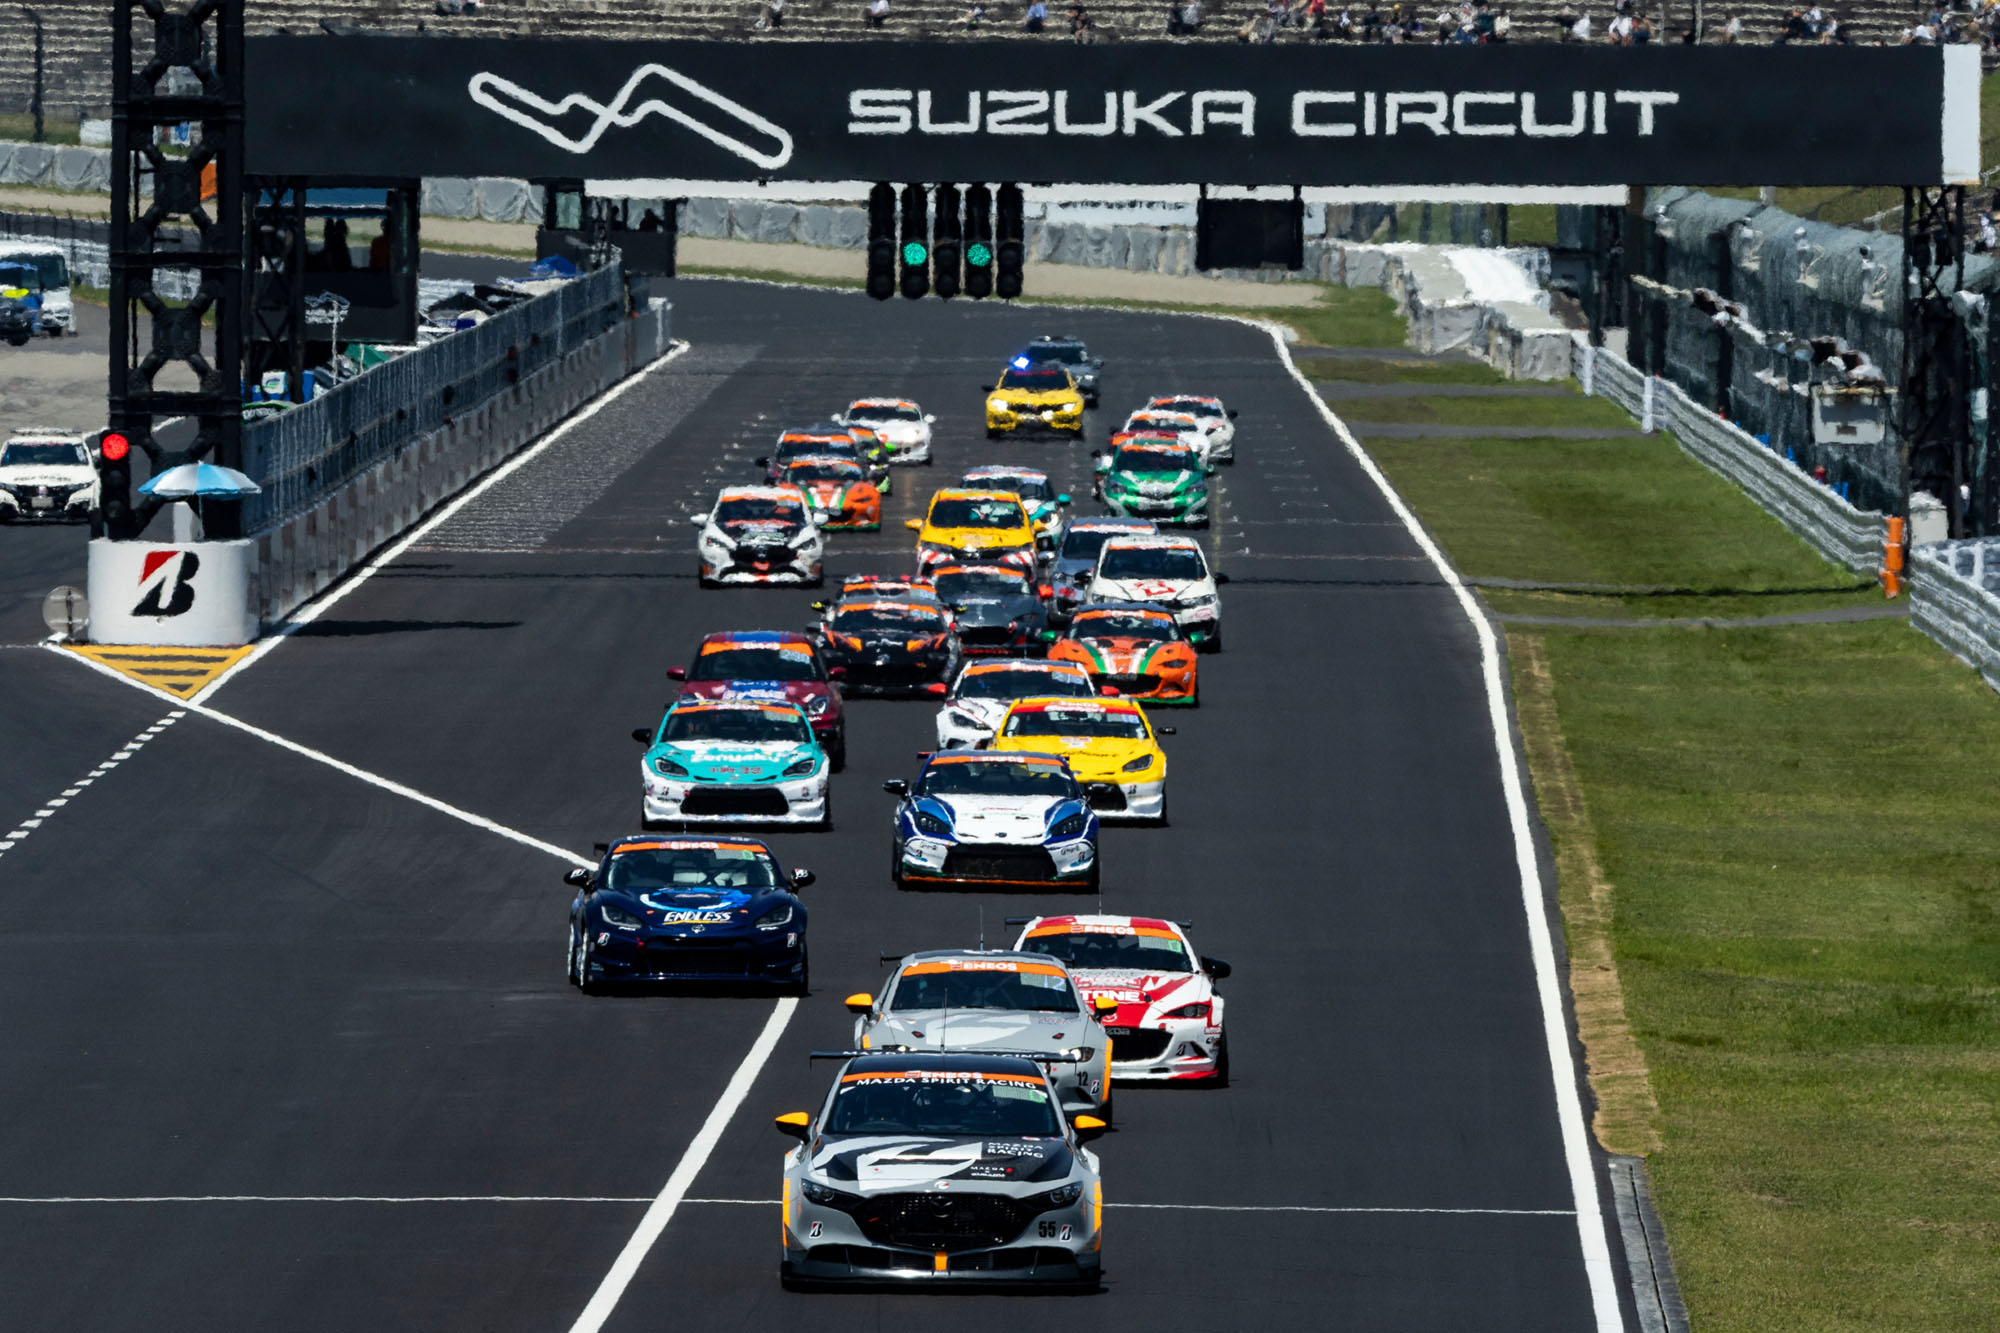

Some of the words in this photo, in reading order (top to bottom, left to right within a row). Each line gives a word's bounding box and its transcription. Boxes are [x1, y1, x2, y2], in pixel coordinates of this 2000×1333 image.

[847, 89, 1256, 136] SUZUKA
[1291, 90, 1679, 136] CIRCUIT
[664, 911, 733, 922] ENDLESS
[1084, 926, 1136, 935] ENEOS
[963, 961, 1017, 971] ENEOS
[920, 1071, 982, 1079] ENEOS
[1077, 1071, 1088, 1087] 12
[856, 1077, 917, 1086] MAZDA
[921, 1077, 963, 1085] SPIRIT
[976, 1078, 1036, 1089] RACING
[986, 1148, 1044, 1159] RACING
[1038, 1221, 1056, 1238] 55
